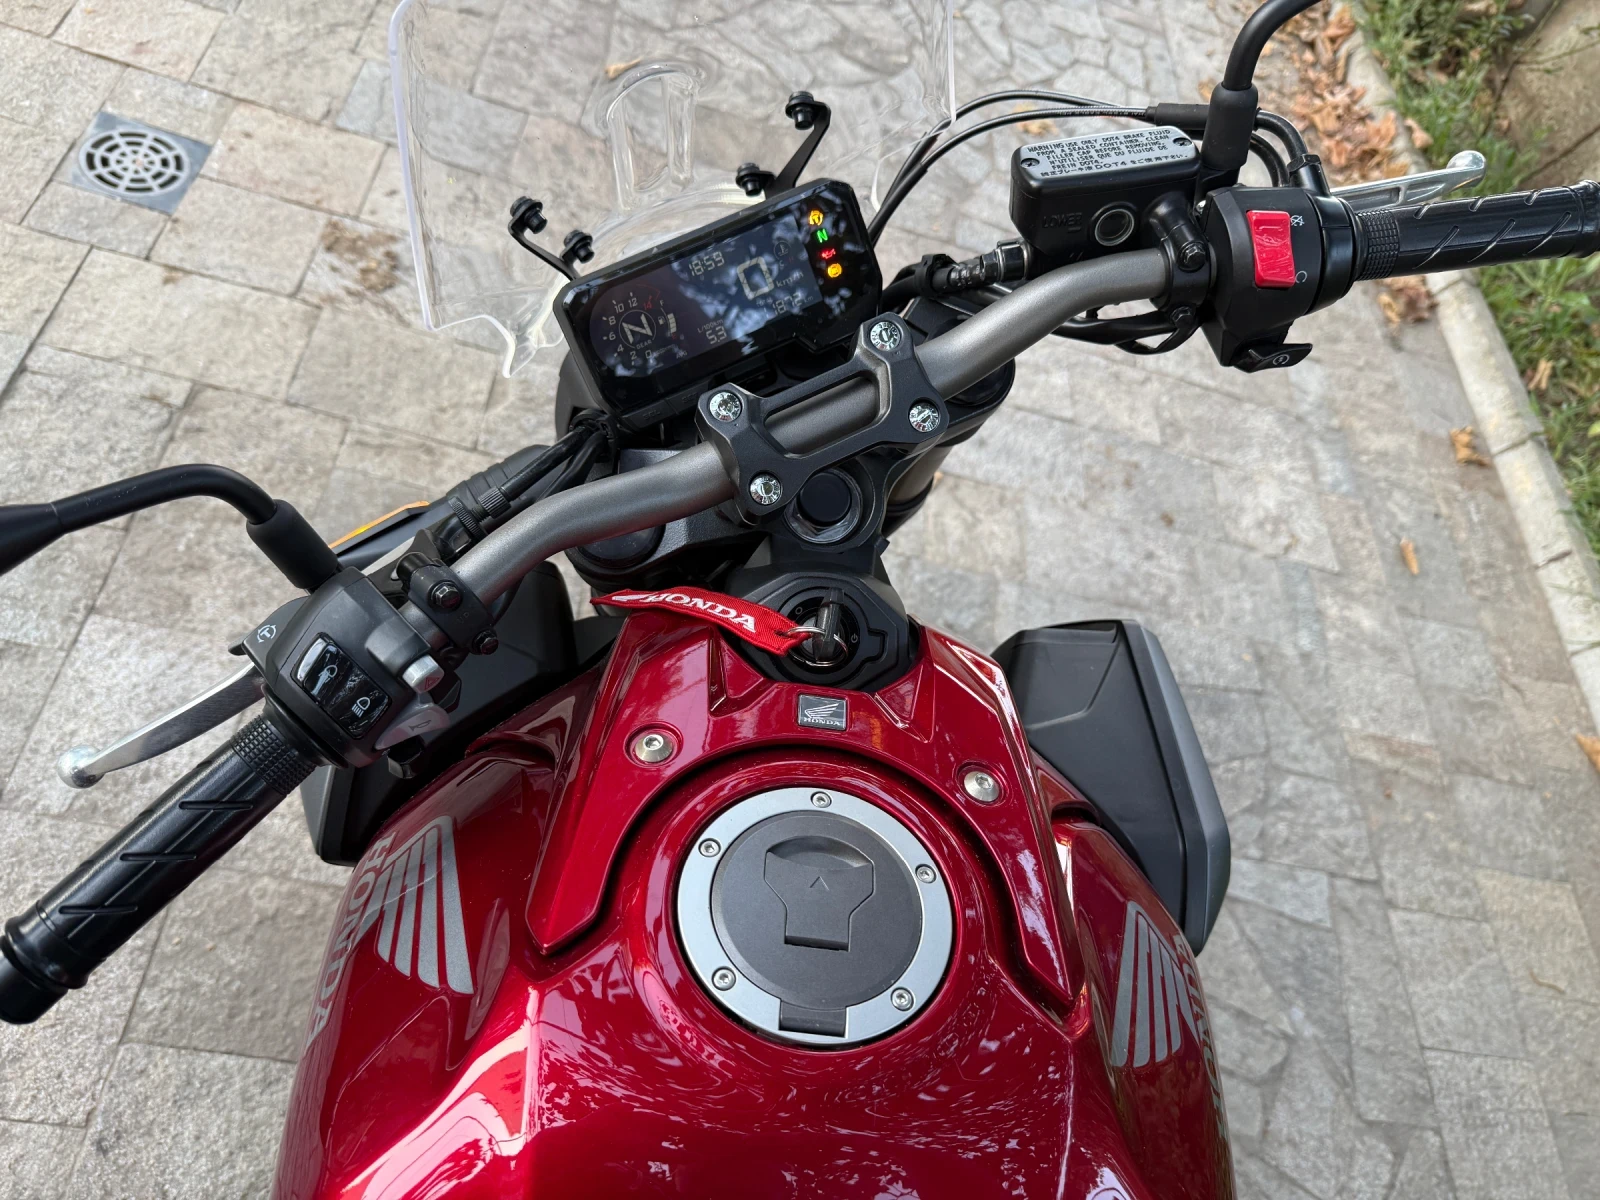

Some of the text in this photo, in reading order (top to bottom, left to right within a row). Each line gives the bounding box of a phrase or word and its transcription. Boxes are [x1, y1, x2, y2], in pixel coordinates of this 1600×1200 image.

[1027, 143, 1064, 153] WARNING
[1070, 144, 1096, 152] SEALED
[817, 228, 828, 243] N
[689, 251, 725, 276] 18:59
[737, 256, 775, 300] 0
[614, 303, 625, 313] 10
[628, 298, 638, 308] 12
[643, 301, 653, 310] 14
[608, 316, 616, 325] 8
[621, 313, 653, 344] N
[609, 332, 616, 340] 6
[706, 325, 727, 344] 5.3
[617, 344, 624, 352] 4
[630, 351, 637, 360] 2
[640, 593, 756, 633] HONDA
[803, 717, 841, 726] HONDA
[305, 831, 397, 1049] HONDA
